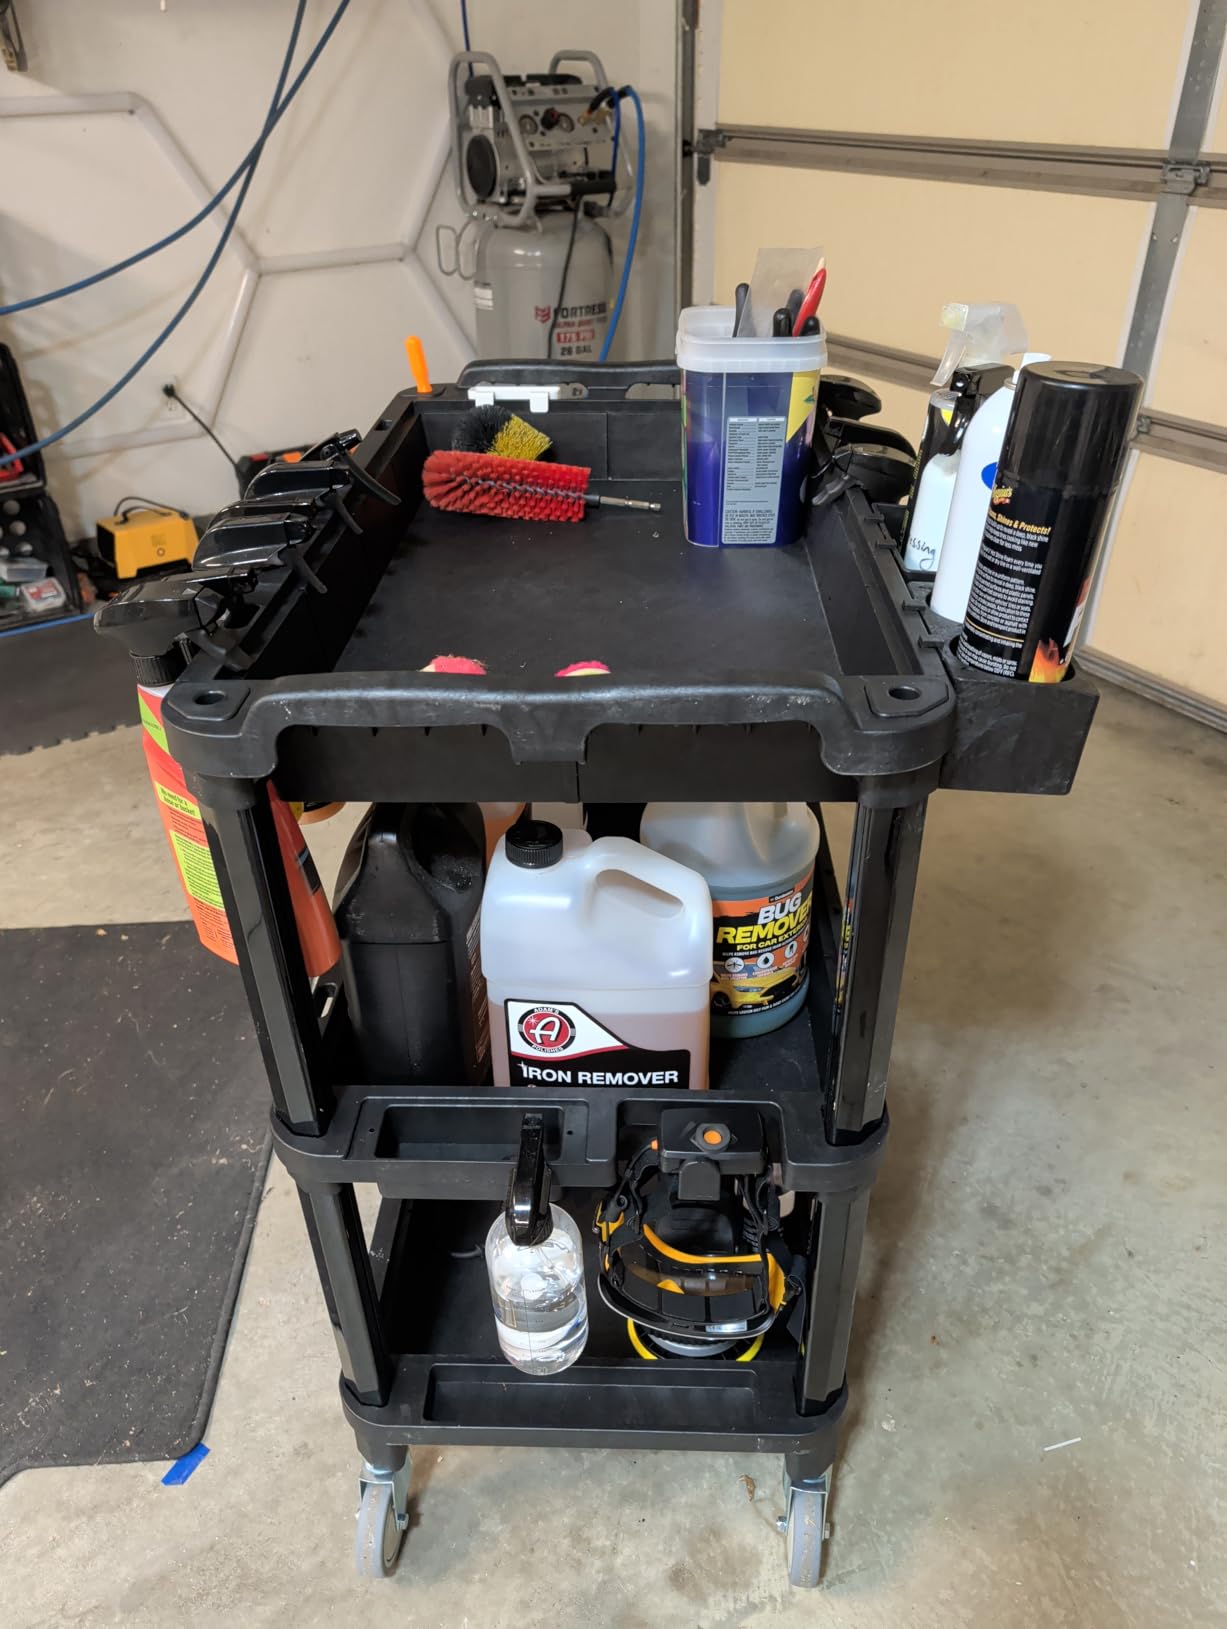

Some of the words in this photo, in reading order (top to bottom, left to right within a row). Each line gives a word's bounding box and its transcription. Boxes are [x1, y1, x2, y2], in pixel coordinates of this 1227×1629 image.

[1013, 520, 1018, 528] &
[1019, 521, 1051, 535] Protects!
[1037, 535, 1049, 543] shine
[758, 892, 802, 924] BUG
[736, 943, 757, 951] FOR
[758, 938, 778, 949] CAR
[533, 1007, 560, 1015] ADAM'S
[529, 1016, 561, 1044] A
[520, 1063, 572, 1083] IRON
[578, 1070, 679, 1086] REMOVER
